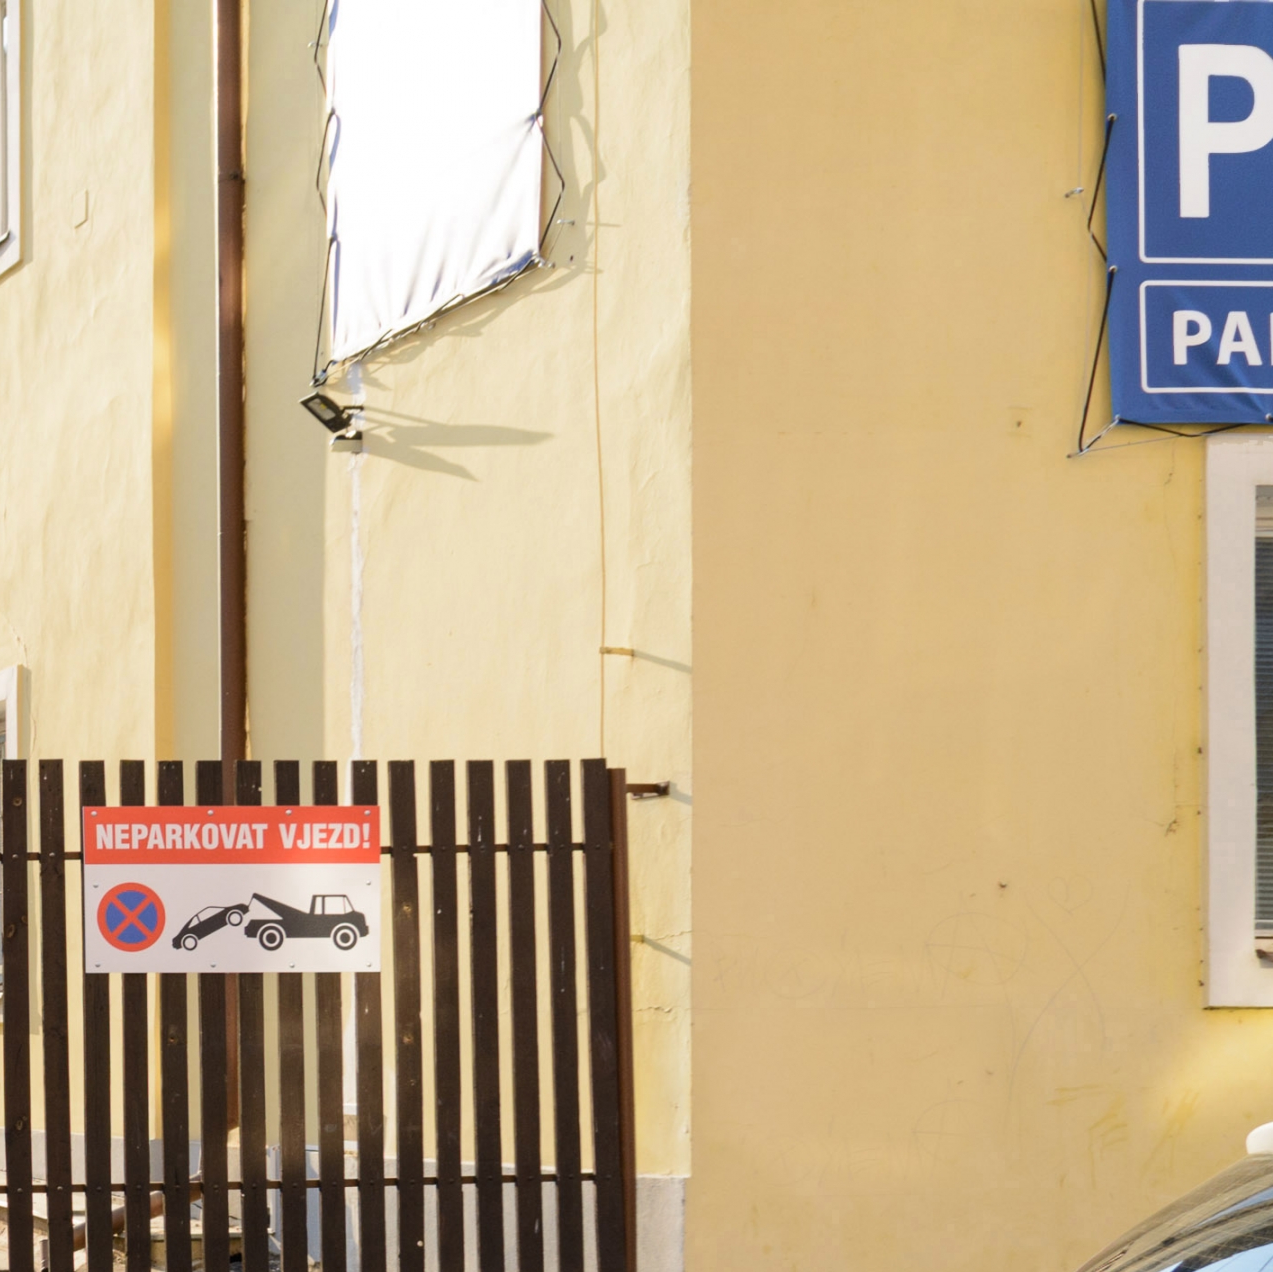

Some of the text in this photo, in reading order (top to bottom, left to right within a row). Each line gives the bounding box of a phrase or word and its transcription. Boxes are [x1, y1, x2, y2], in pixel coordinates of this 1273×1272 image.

[1178, 43, 1273, 218] P
[1172, 310, 1273, 366] PA
[95, 822, 371, 850] NEPARKOVAT VJEZD!
